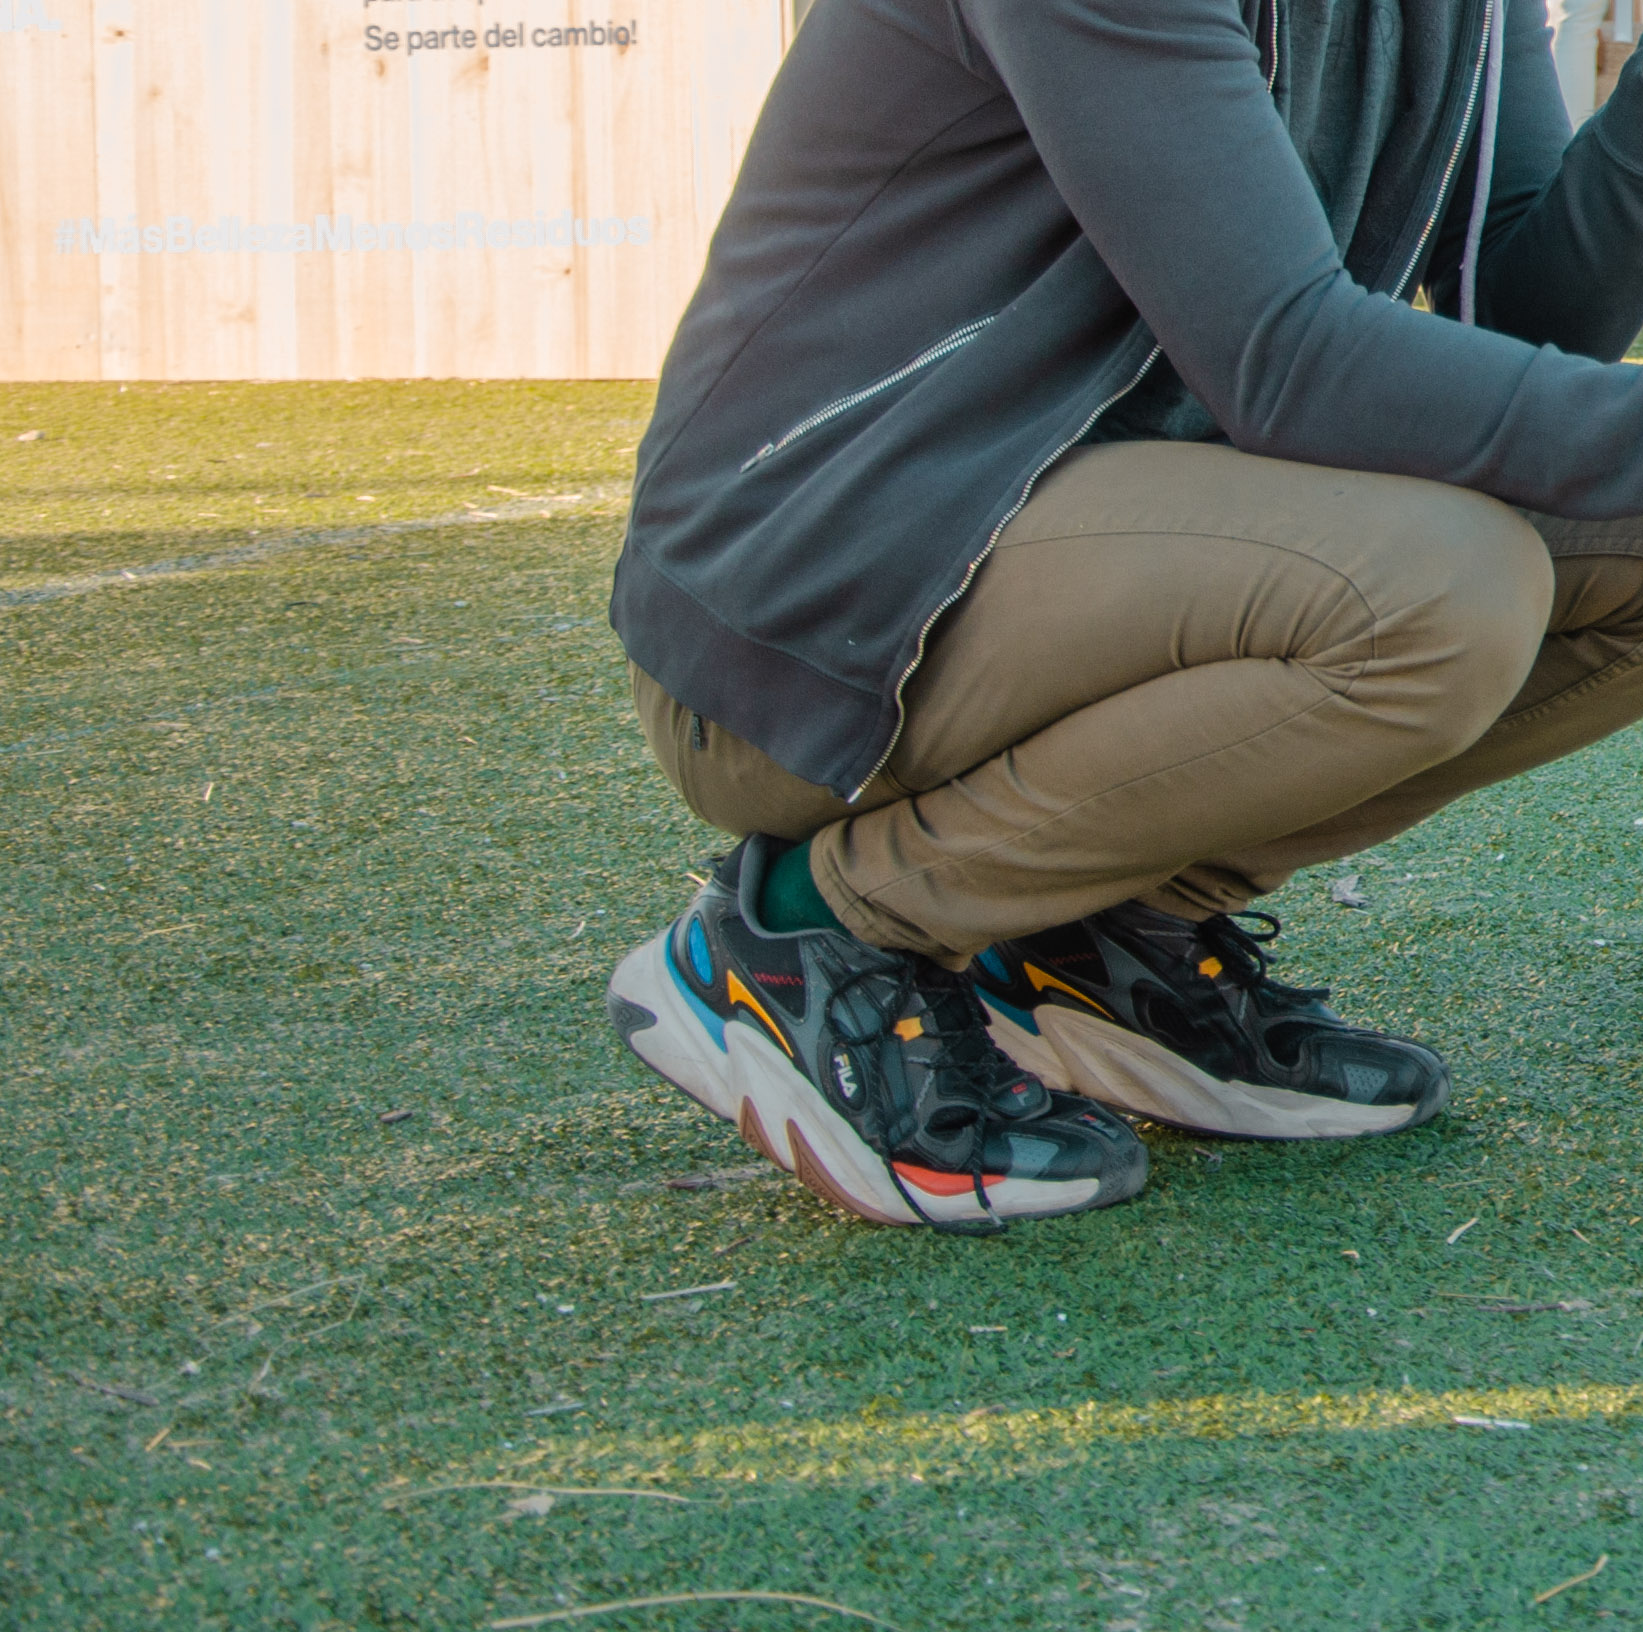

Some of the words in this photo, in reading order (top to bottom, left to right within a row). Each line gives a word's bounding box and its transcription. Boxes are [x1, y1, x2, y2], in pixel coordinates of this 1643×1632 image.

[364, 24, 400, 52] Se
[406, 25, 477, 56] parte
[484, 21, 525, 49] del
[531, 19, 637, 48] cambio!
[54, 210, 651, 256] #MásBellezaMenosResiduos
[833, 1053, 858, 1098] FILA
